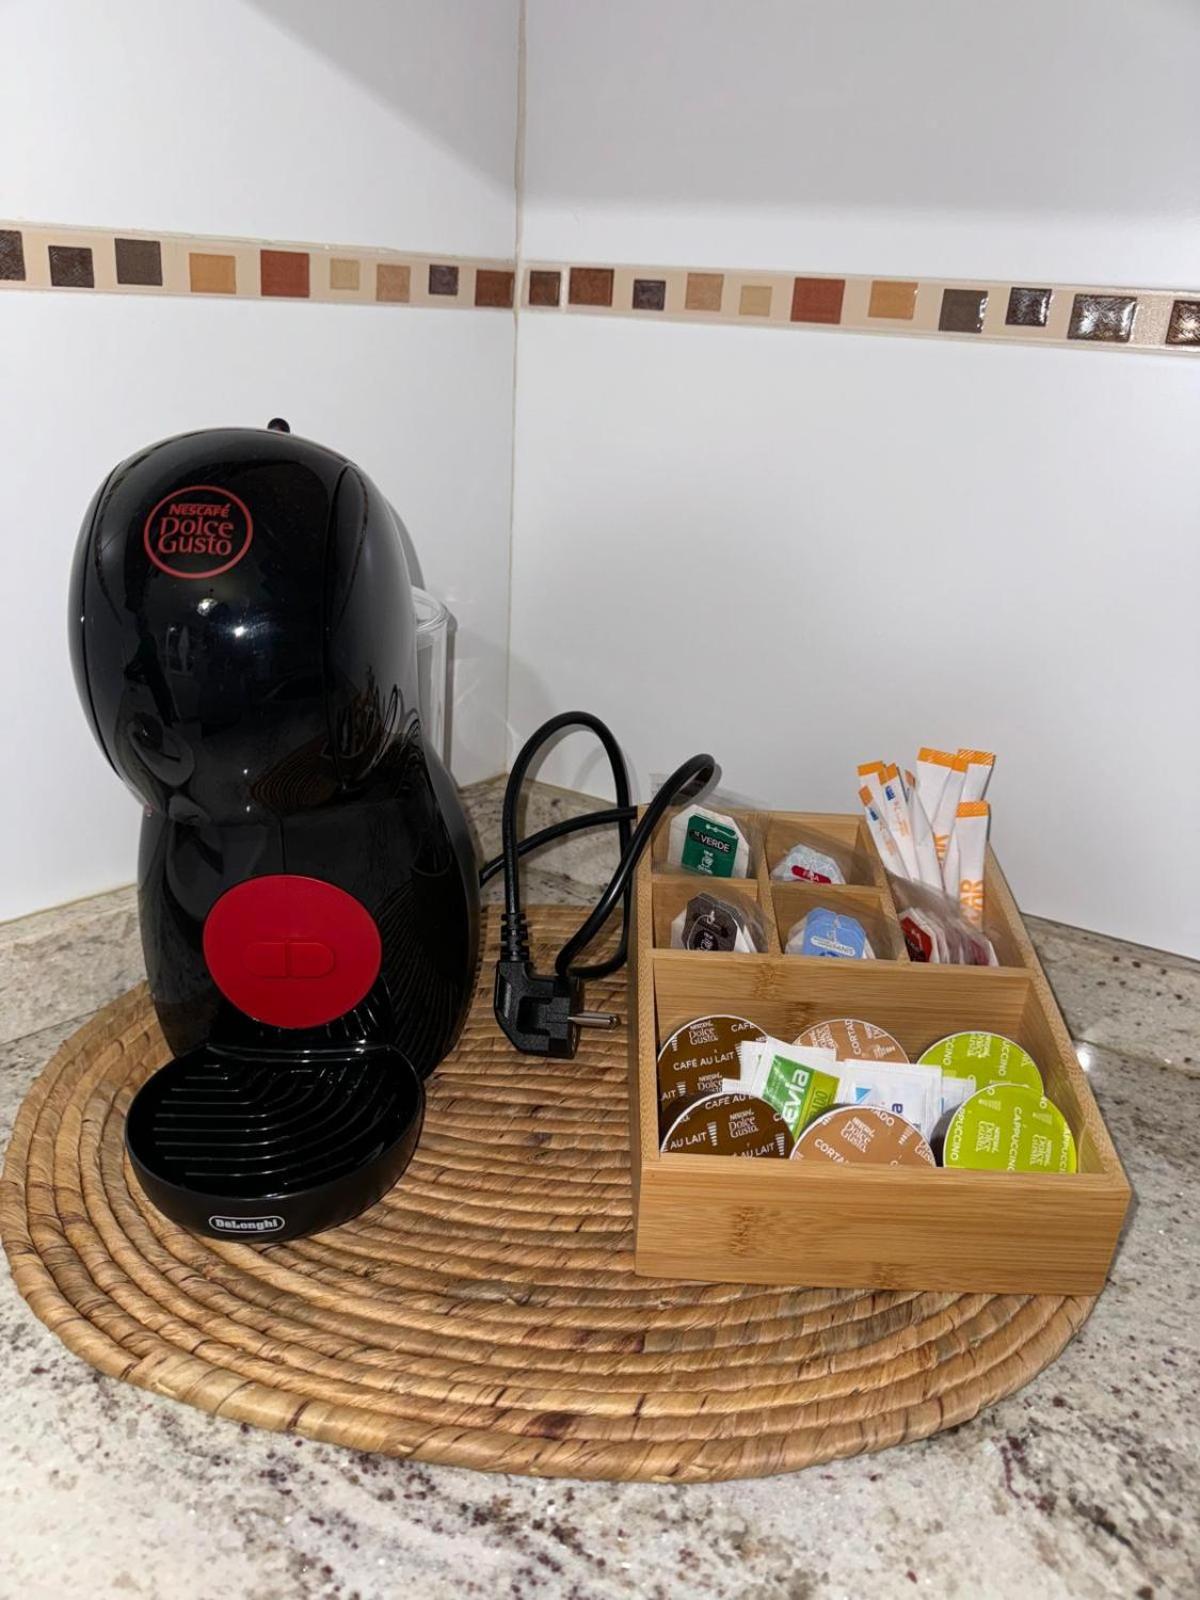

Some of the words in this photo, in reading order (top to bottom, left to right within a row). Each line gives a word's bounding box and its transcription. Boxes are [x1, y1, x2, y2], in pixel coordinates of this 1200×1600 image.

[169, 503, 231, 518] NESCAFÉ
[160, 516, 234, 538] Dolce
[158, 535, 232, 556] Gusto
[700, 834, 731, 853] VERDE
[700, 1056, 713, 1067] AU
[714, 1051, 735, 1063] LAIT
[670, 1138, 684, 1150] AU
[685, 1131, 708, 1146] LAIT
[755, 1142, 775, 1157] LAIT
[215, 1219, 278, 1231] DeLonghi
